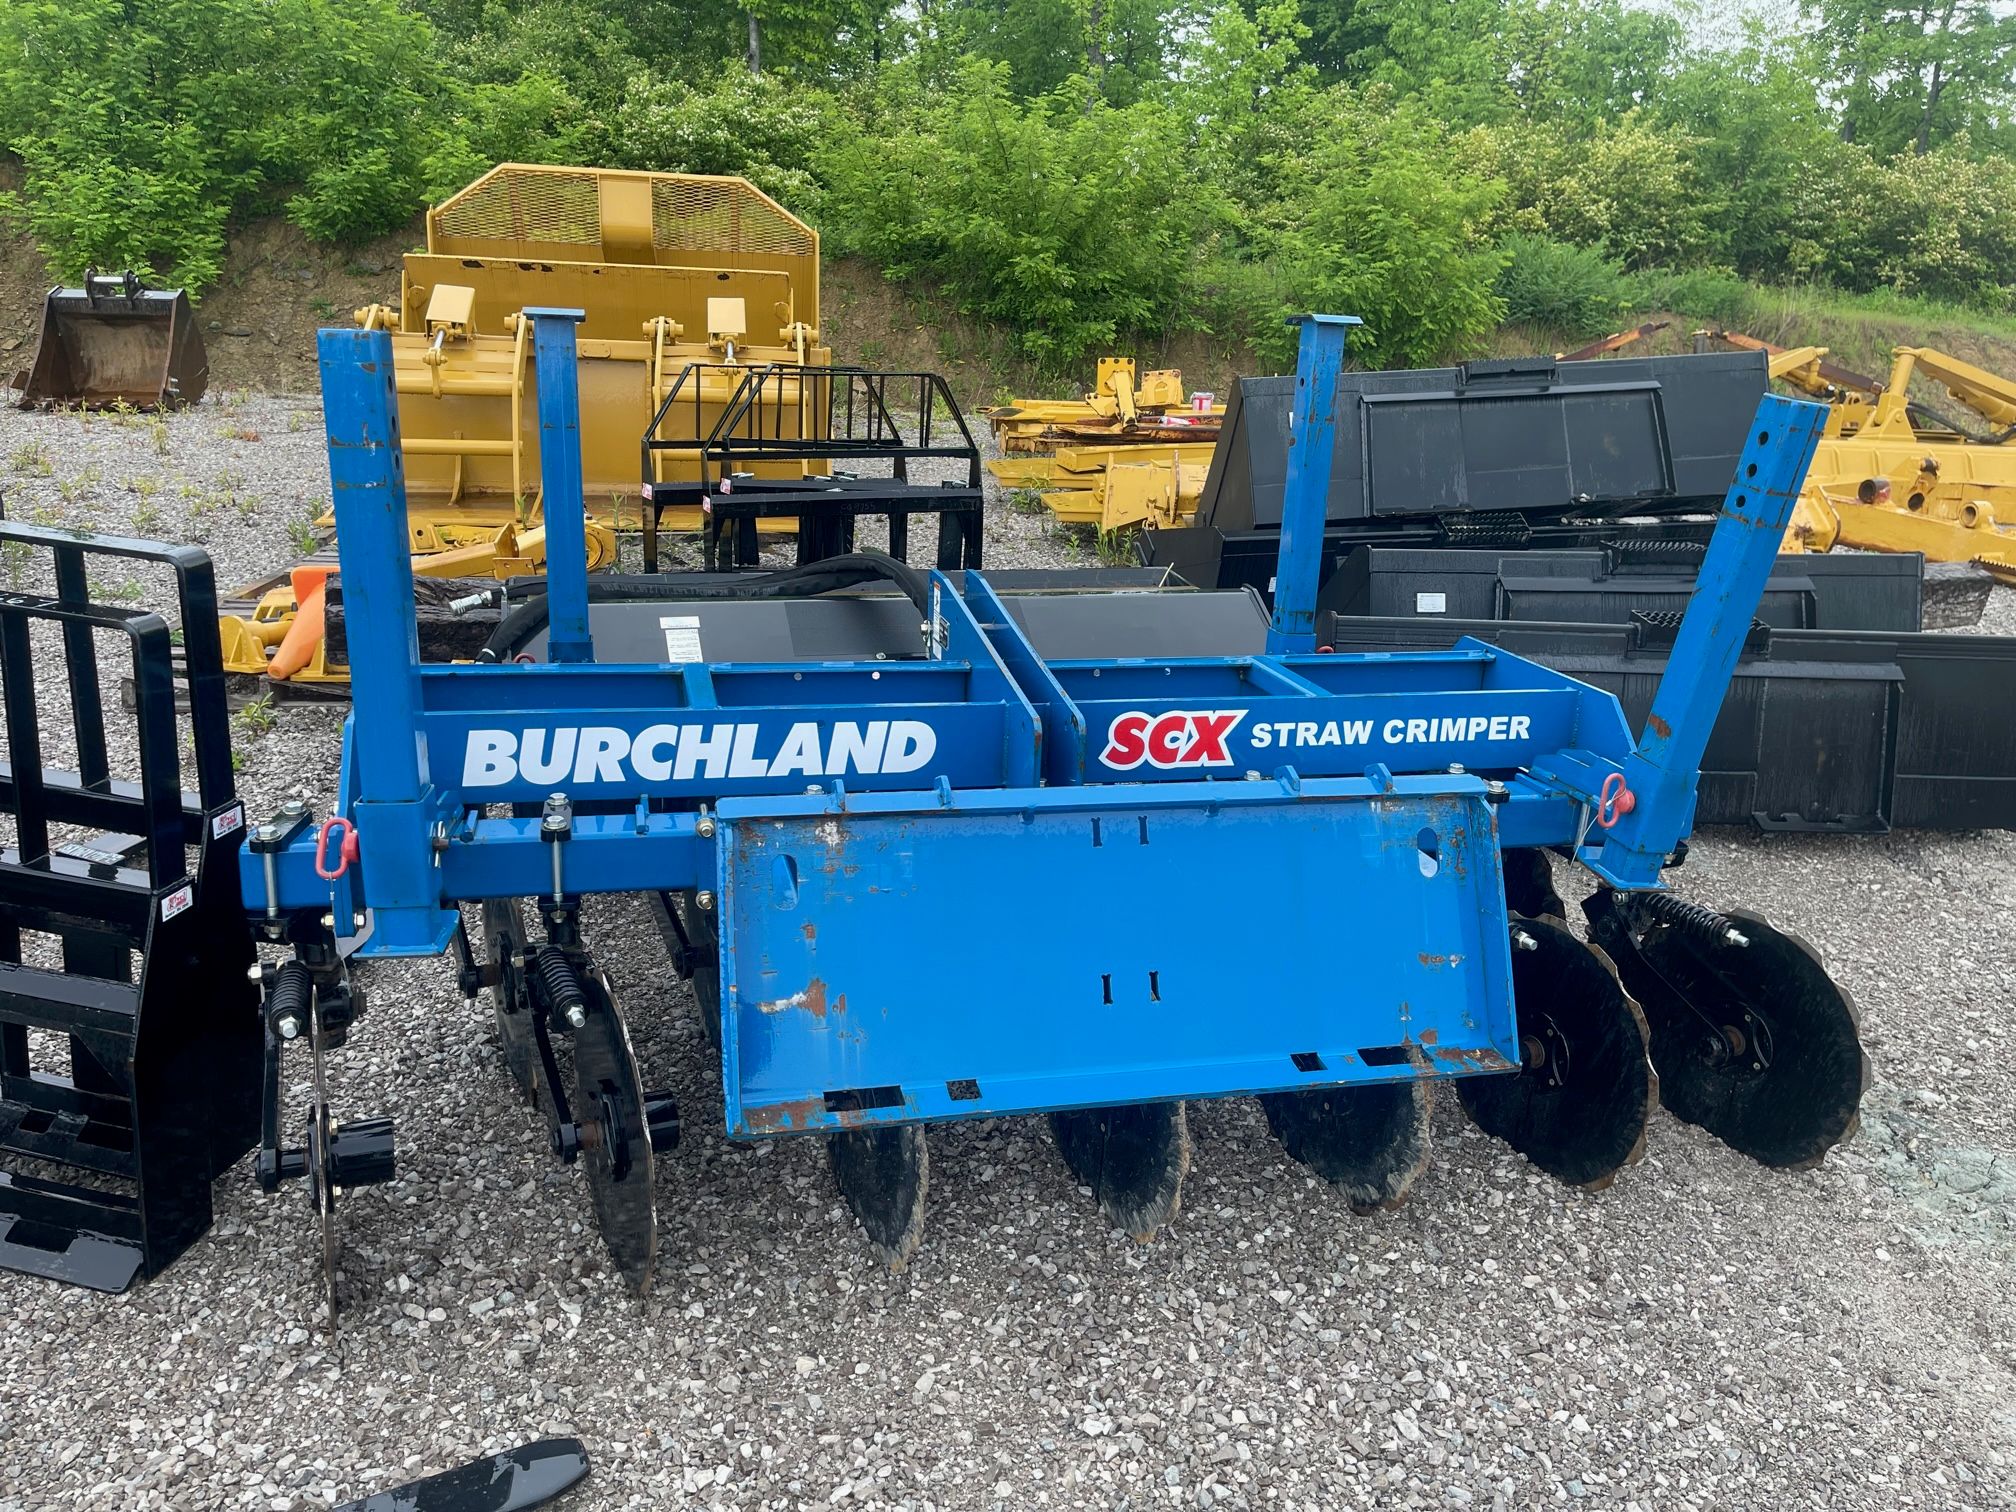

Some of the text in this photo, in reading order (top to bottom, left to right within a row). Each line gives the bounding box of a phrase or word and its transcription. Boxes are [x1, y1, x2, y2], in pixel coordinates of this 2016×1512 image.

[462, 720, 937, 787] BURCHLAND
[1101, 712, 1531, 769] SCX STRAW CRIMPER
